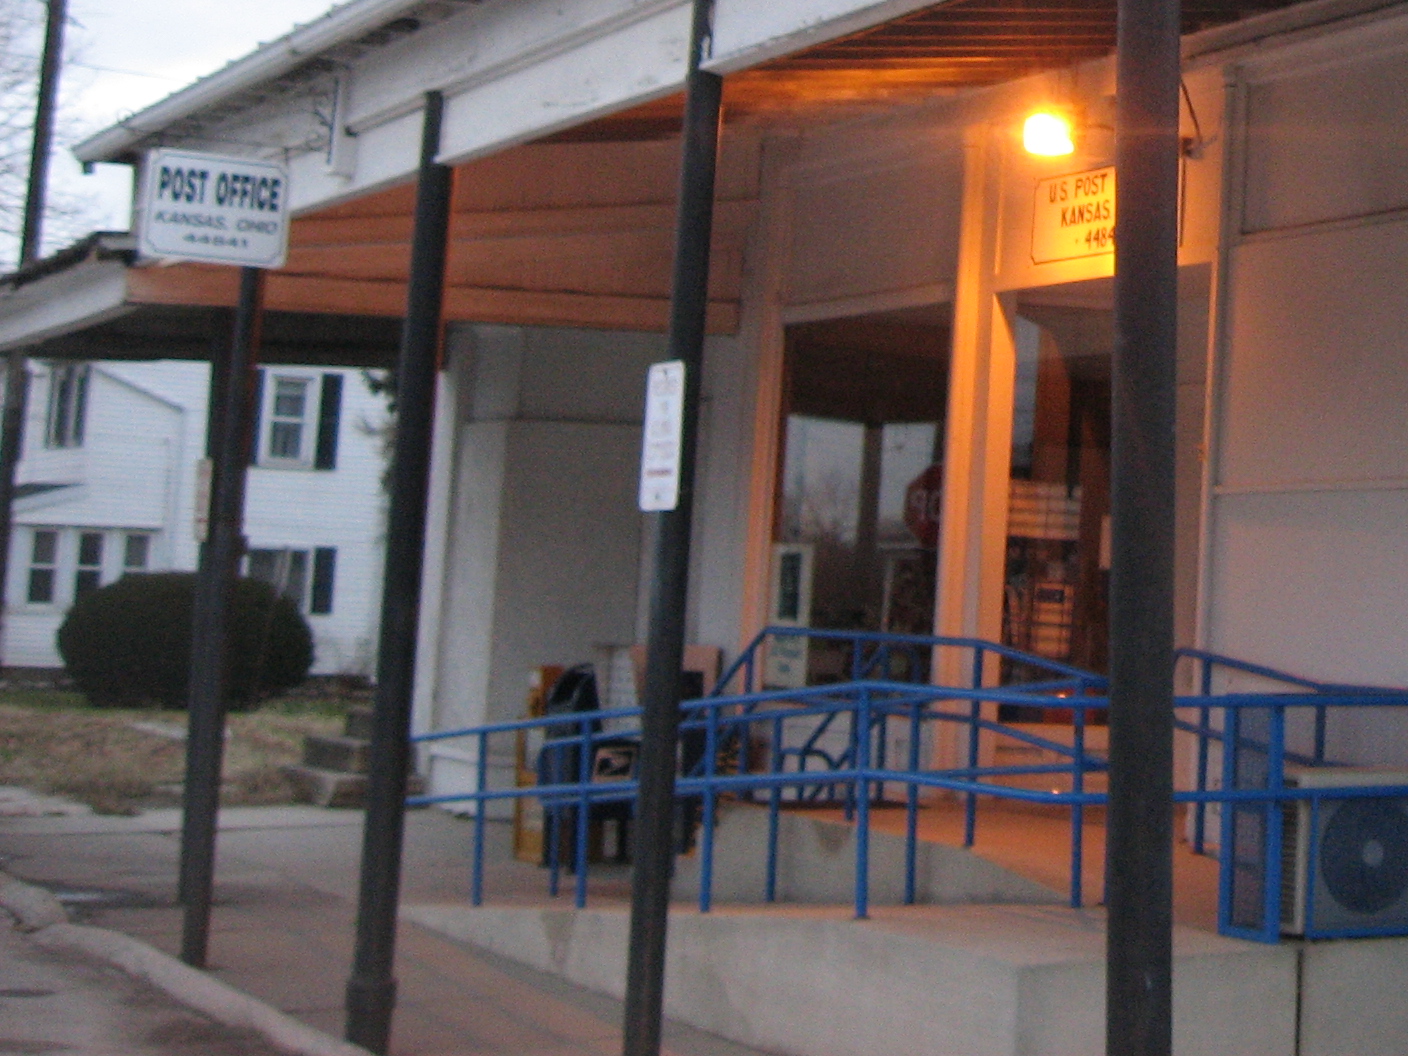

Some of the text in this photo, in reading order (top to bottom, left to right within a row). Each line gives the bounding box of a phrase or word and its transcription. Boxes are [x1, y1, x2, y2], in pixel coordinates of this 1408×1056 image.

[159, 165, 281, 212] POST OFFICE
[1074, 172, 1108, 199] POST
[1085, 225, 1115, 250] 4484
